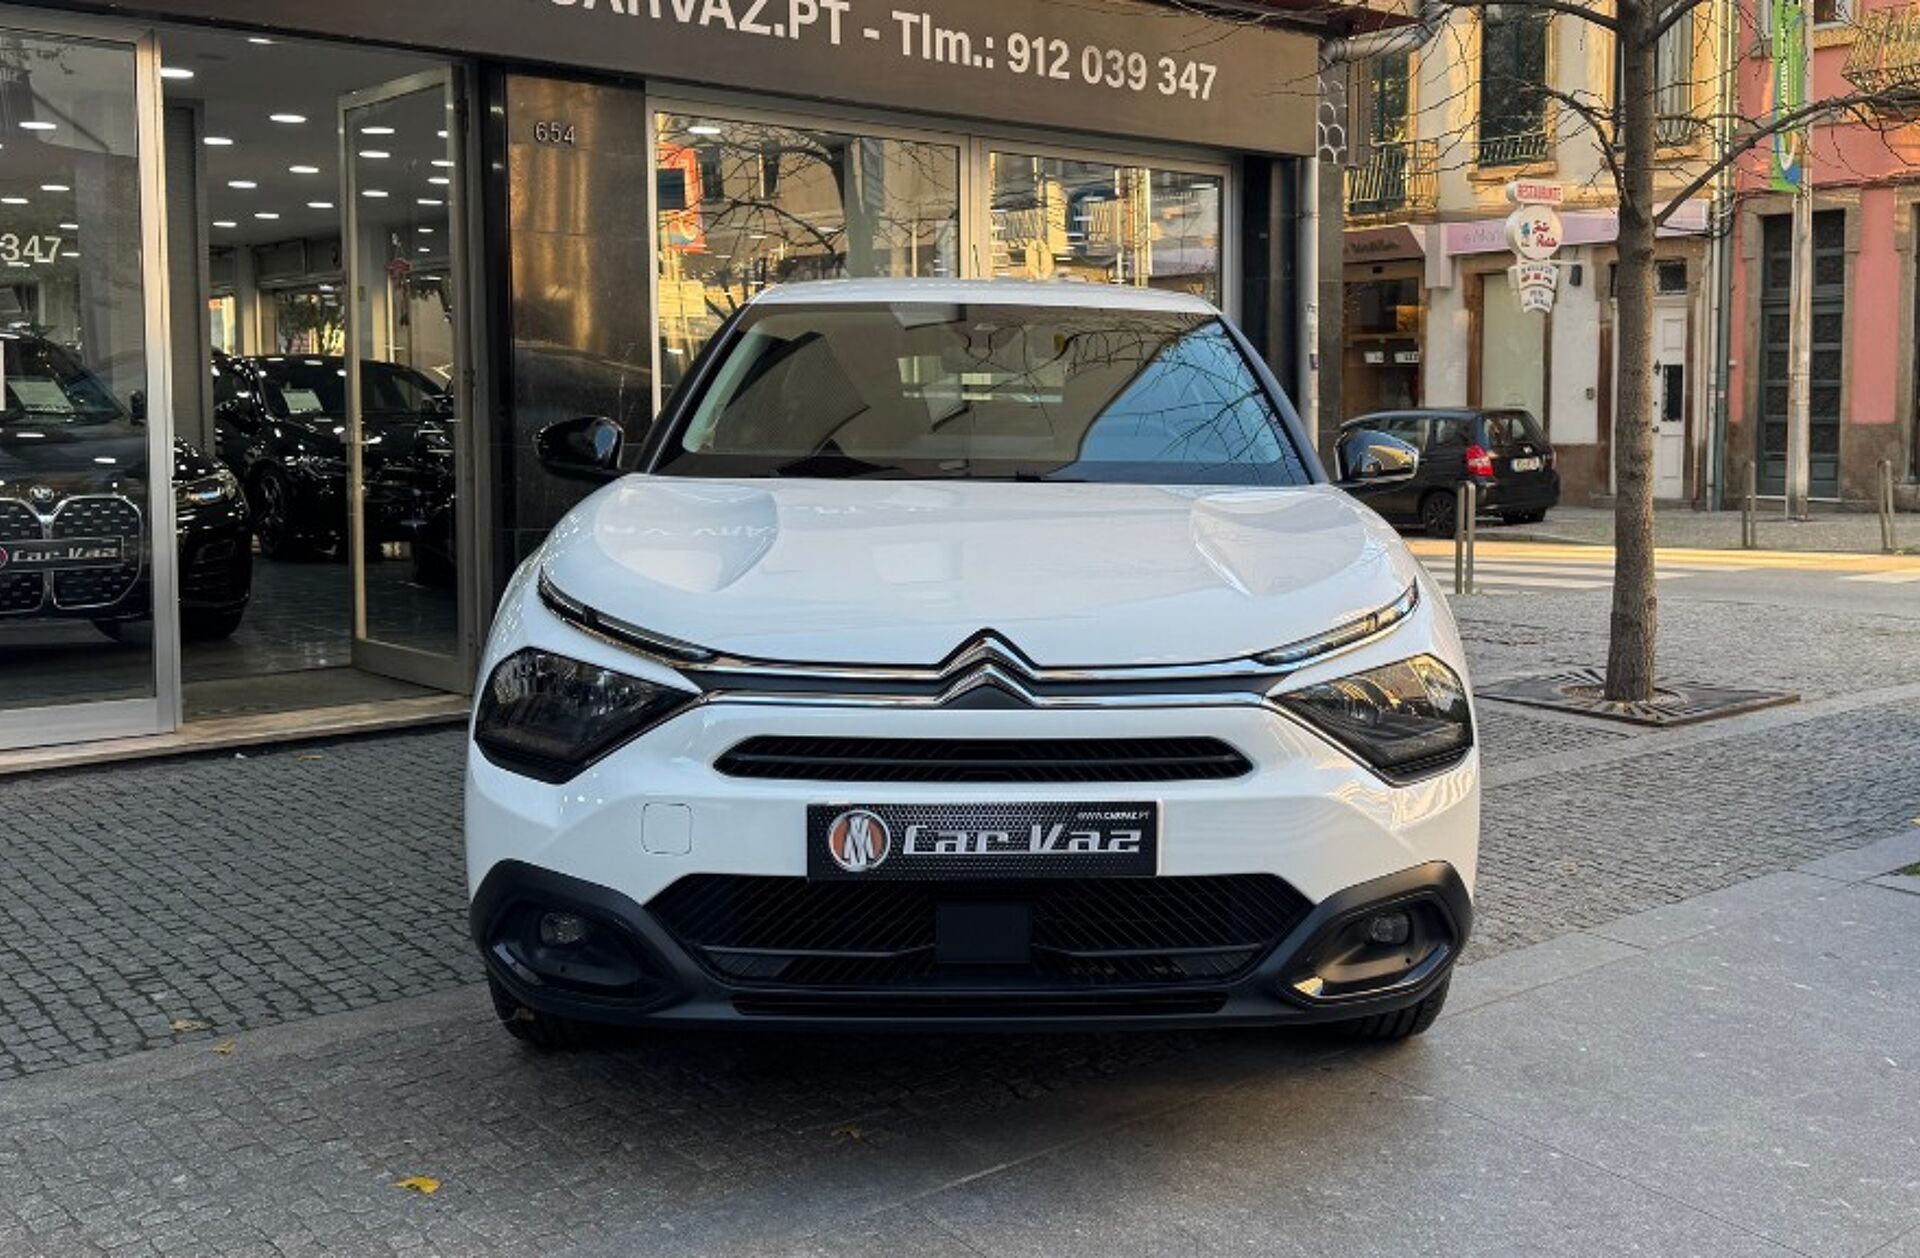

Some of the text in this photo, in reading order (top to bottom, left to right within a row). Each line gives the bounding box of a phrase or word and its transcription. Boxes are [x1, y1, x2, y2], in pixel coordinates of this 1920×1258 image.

[891, 10, 994, 69] Tlm.:
[1007, 32, 1071, 80] 912
[1081, 45, 1147, 91] 039
[1157, 56, 1217, 101] 347
[535, 121, 575, 145] 654
[0, 233, 62, 263] 347
[12, 550, 60, 562] Car
[903, 824, 1142, 854] Car Vaz
